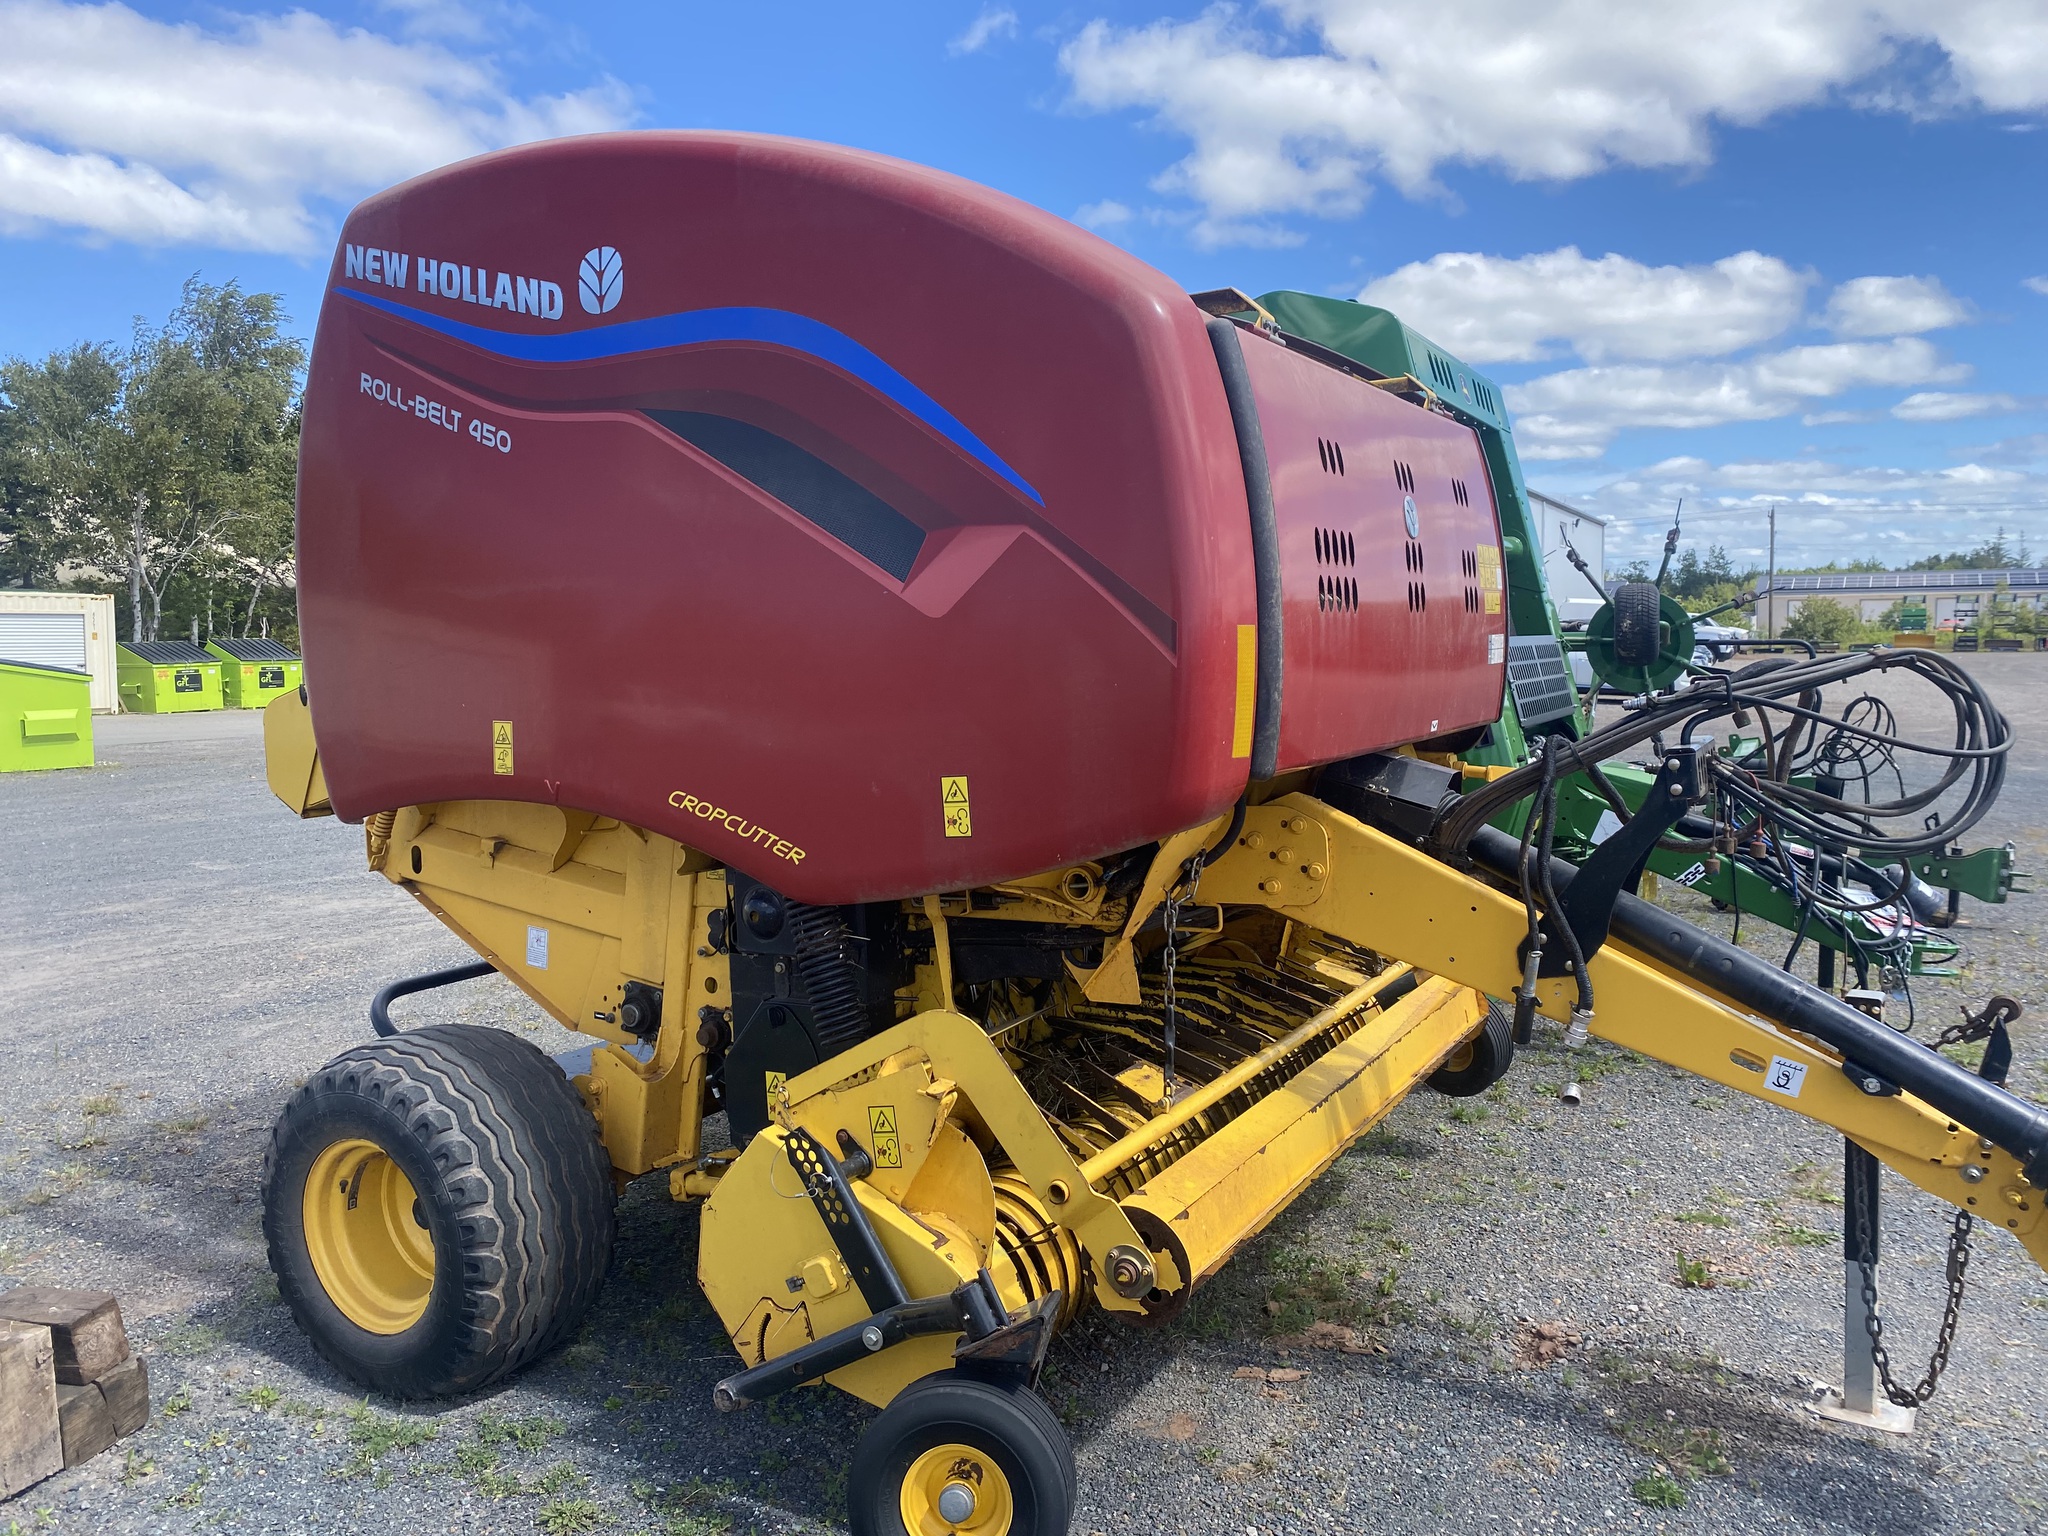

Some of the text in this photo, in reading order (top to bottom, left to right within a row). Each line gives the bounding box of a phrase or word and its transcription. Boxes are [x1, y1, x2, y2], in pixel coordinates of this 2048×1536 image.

[345, 243, 564, 321] NEW HOLLAND
[360, 372, 512, 454] ROLL-BELT 450
[668, 790, 806, 865] CROPCUTTER
